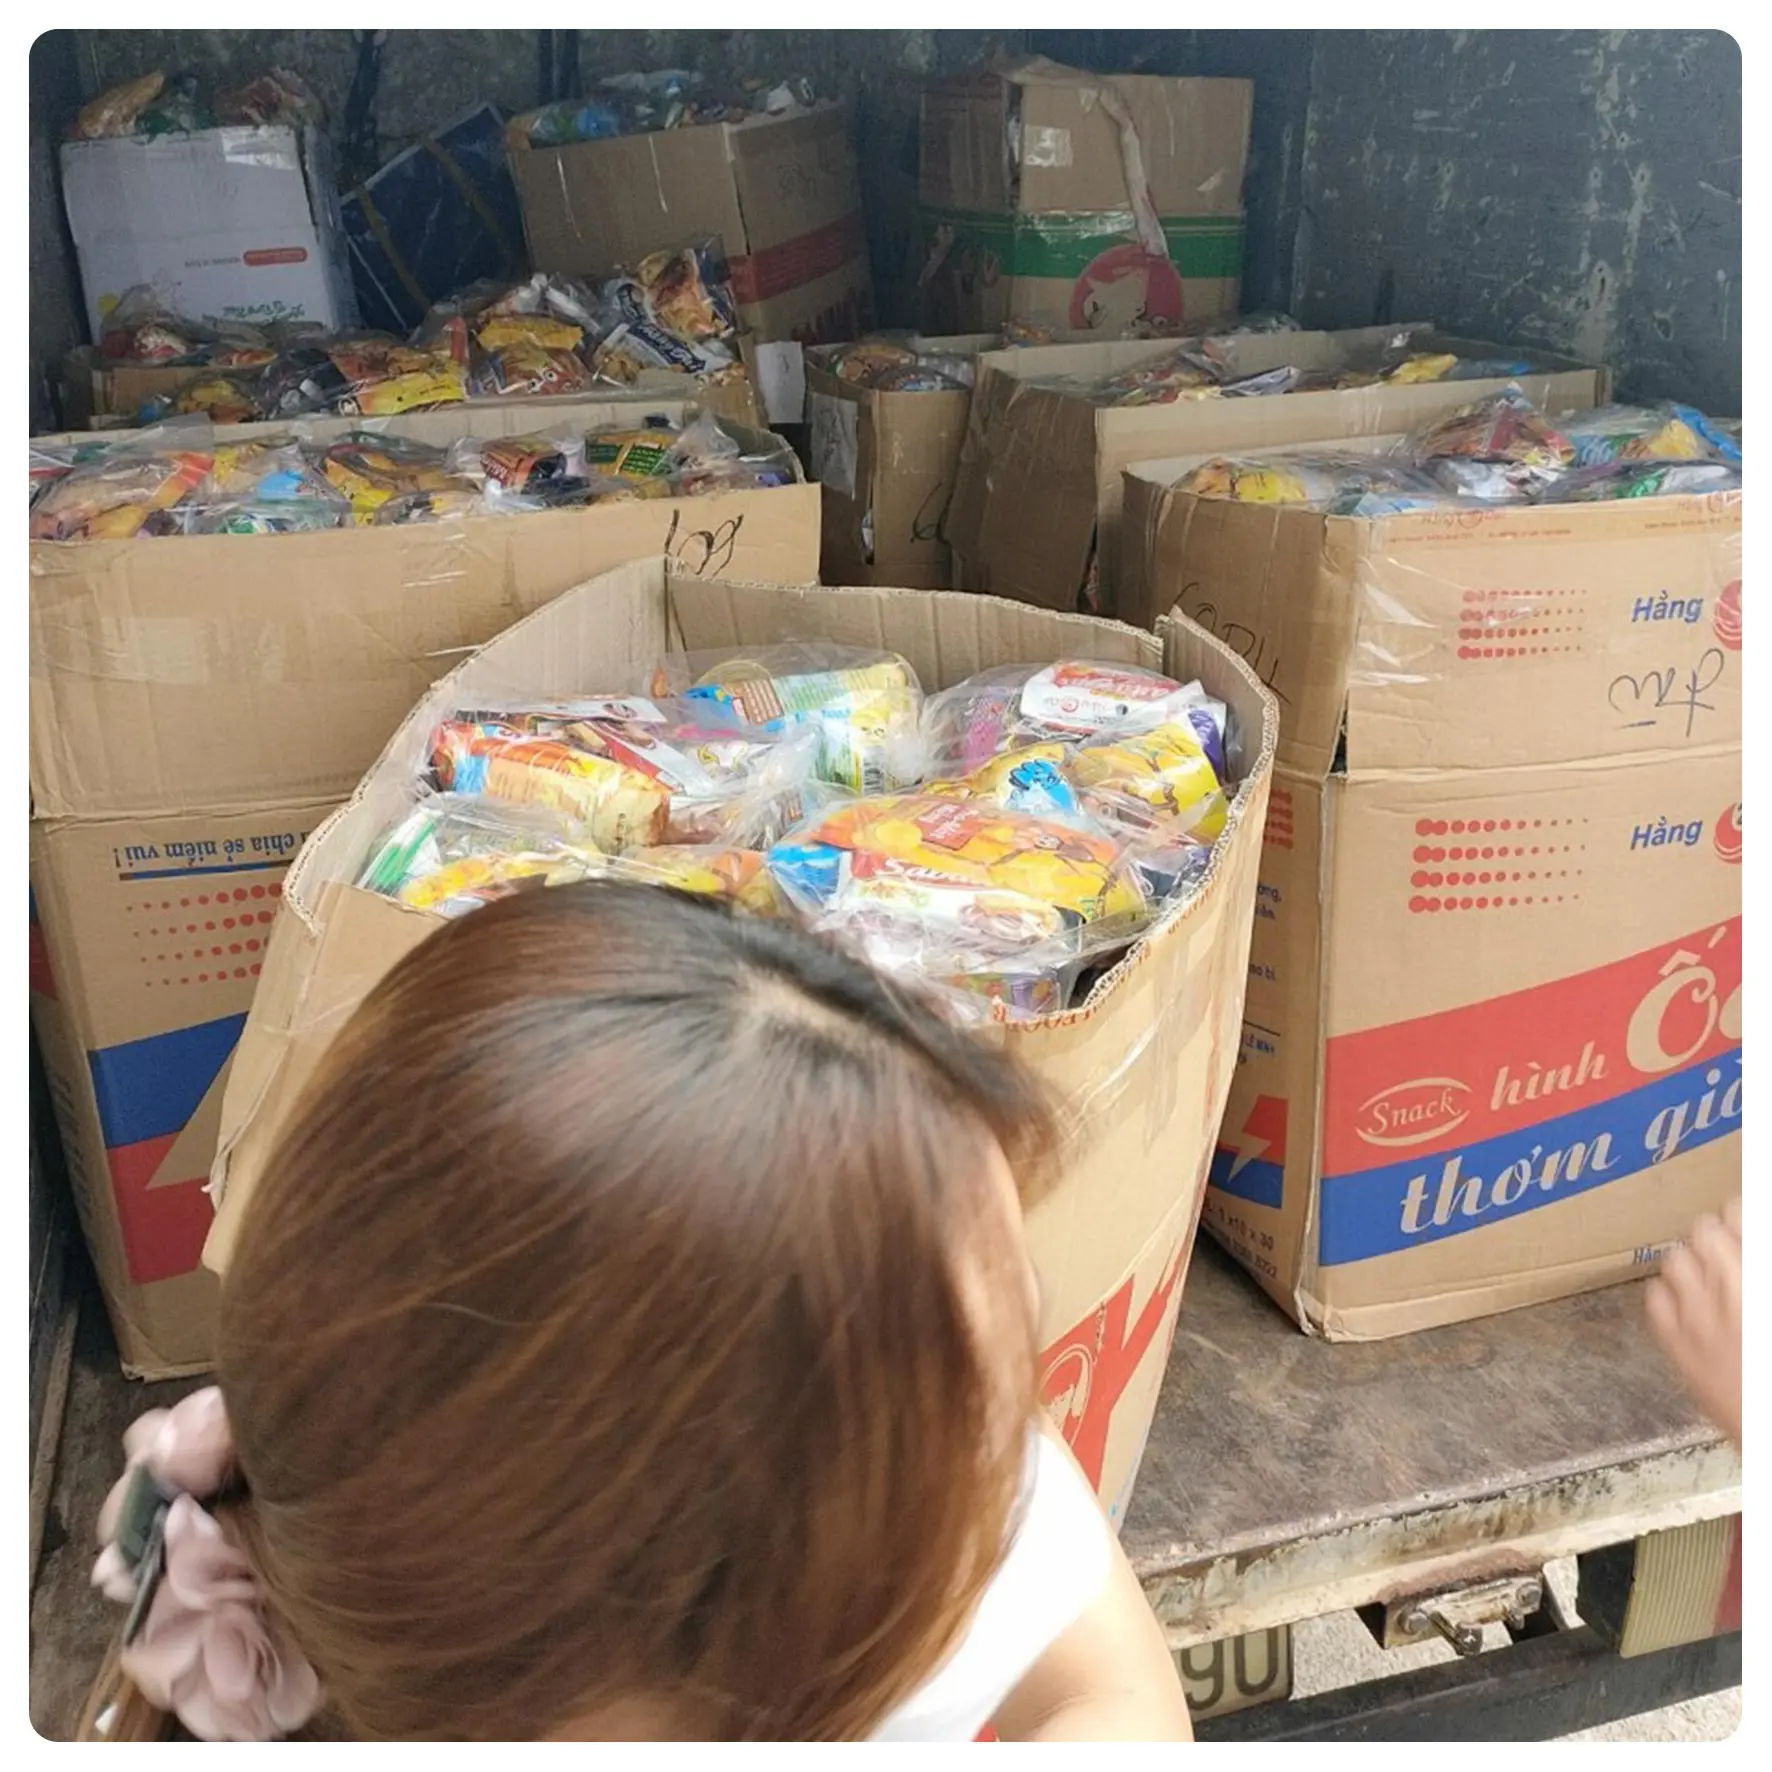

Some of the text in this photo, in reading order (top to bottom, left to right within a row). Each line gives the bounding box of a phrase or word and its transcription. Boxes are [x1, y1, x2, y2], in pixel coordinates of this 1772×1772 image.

[250, 832, 295, 855] chia
[1630, 816, 1703, 850] Hằng
[1367, 1087, 1461, 1135] Snack
[1491, 1040, 1611, 1110] hình
[1401, 1133, 1621, 1234] thơm
